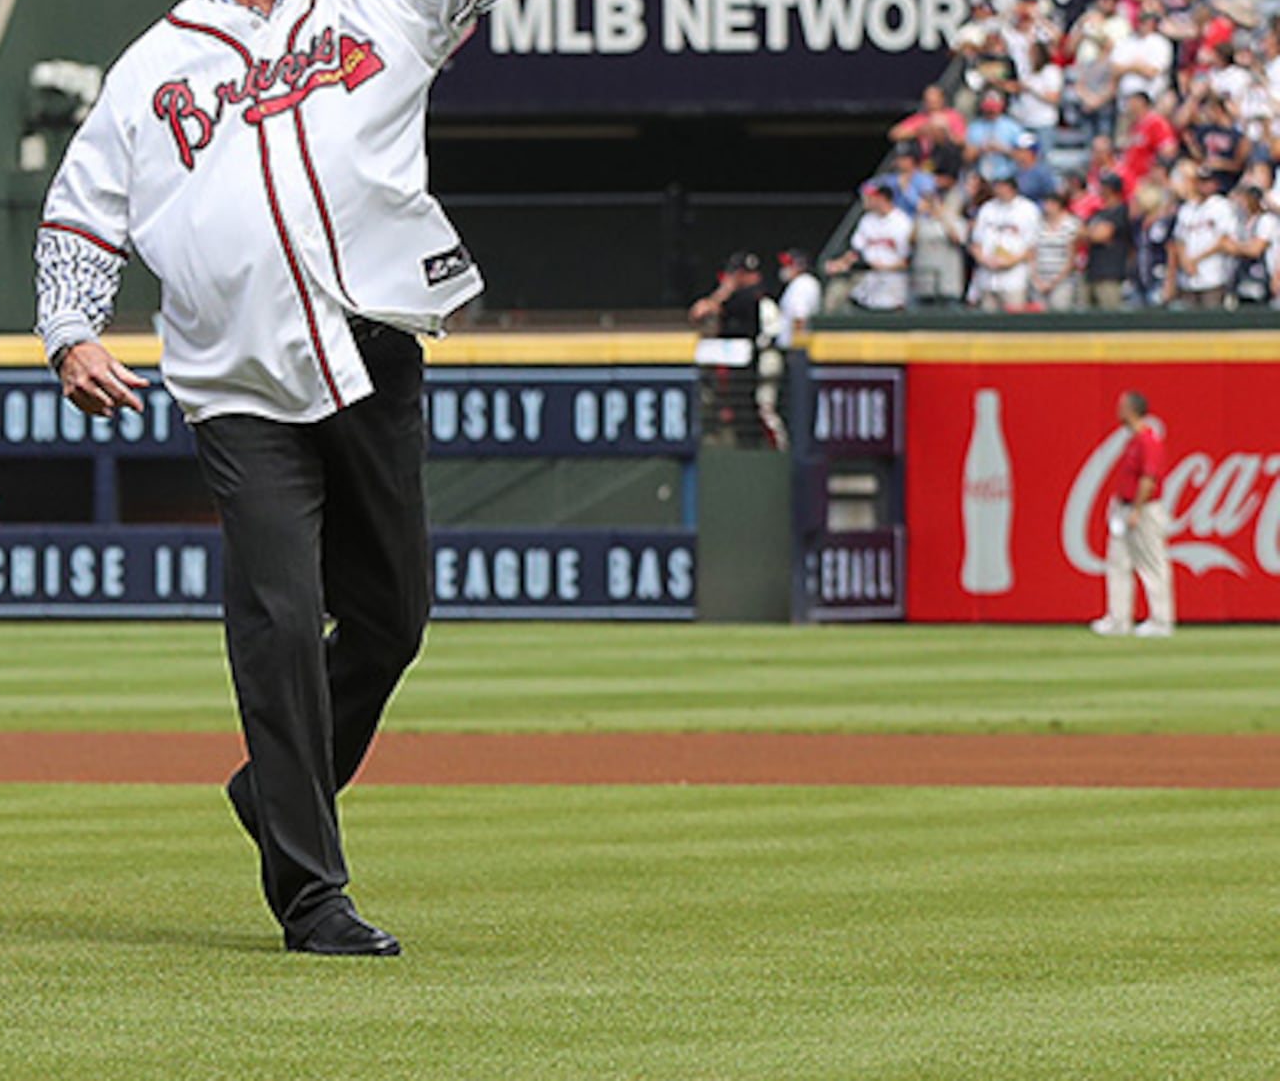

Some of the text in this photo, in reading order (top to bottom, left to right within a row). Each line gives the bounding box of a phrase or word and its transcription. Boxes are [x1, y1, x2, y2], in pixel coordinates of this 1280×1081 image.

[422, 388, 687, 443] USLY OPER
[156, 545, 207, 597] IN
[607, 547, 694, 600] BAS
